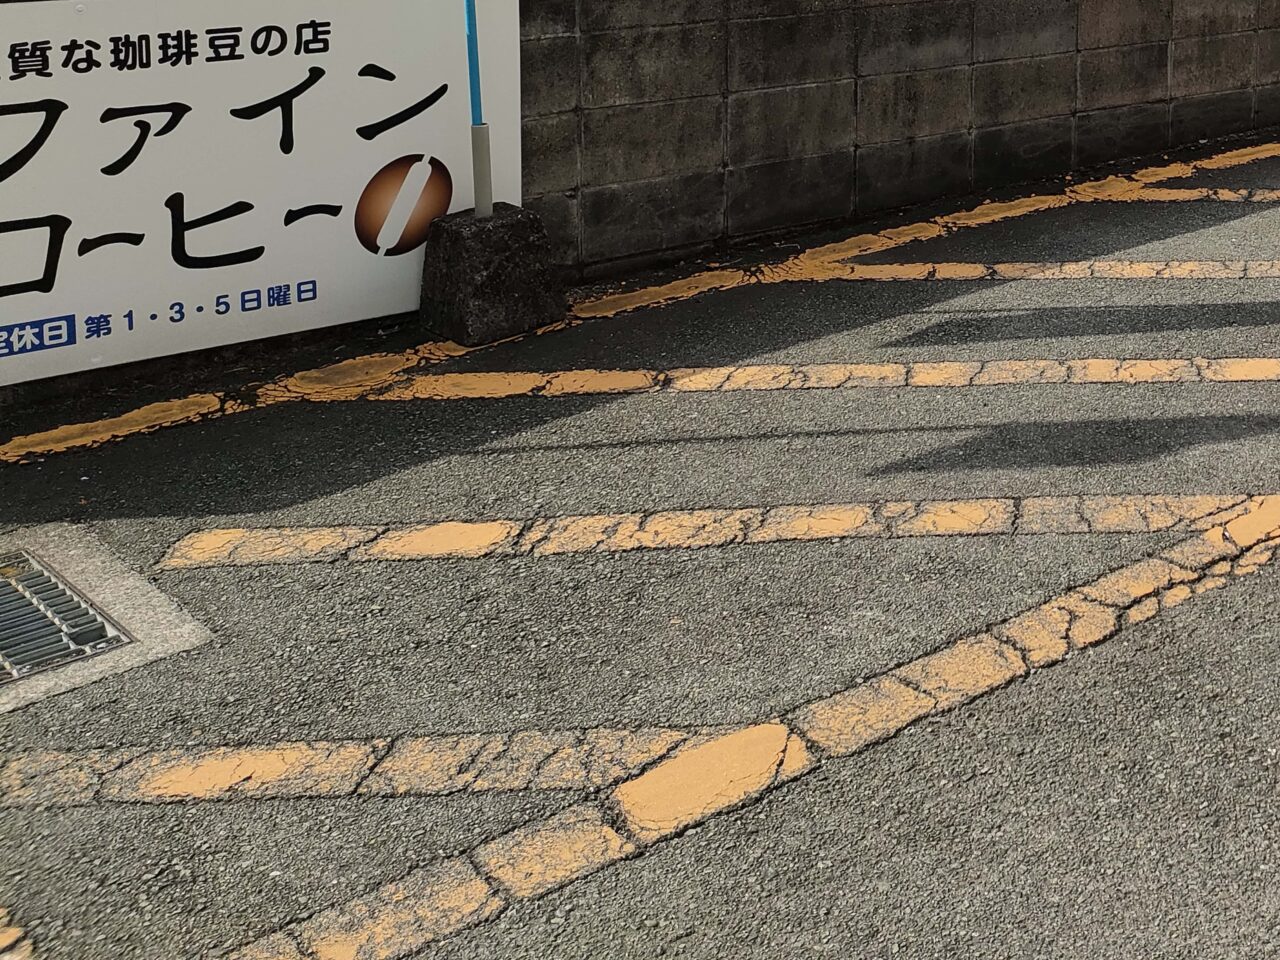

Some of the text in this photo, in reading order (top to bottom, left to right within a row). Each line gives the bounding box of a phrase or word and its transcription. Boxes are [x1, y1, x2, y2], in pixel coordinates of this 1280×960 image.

[8, 20, 331, 80] 質な珈琲豆の店
[0, 63, 449, 182] ファイン
[0, 192, 343, 299] コーヒー
